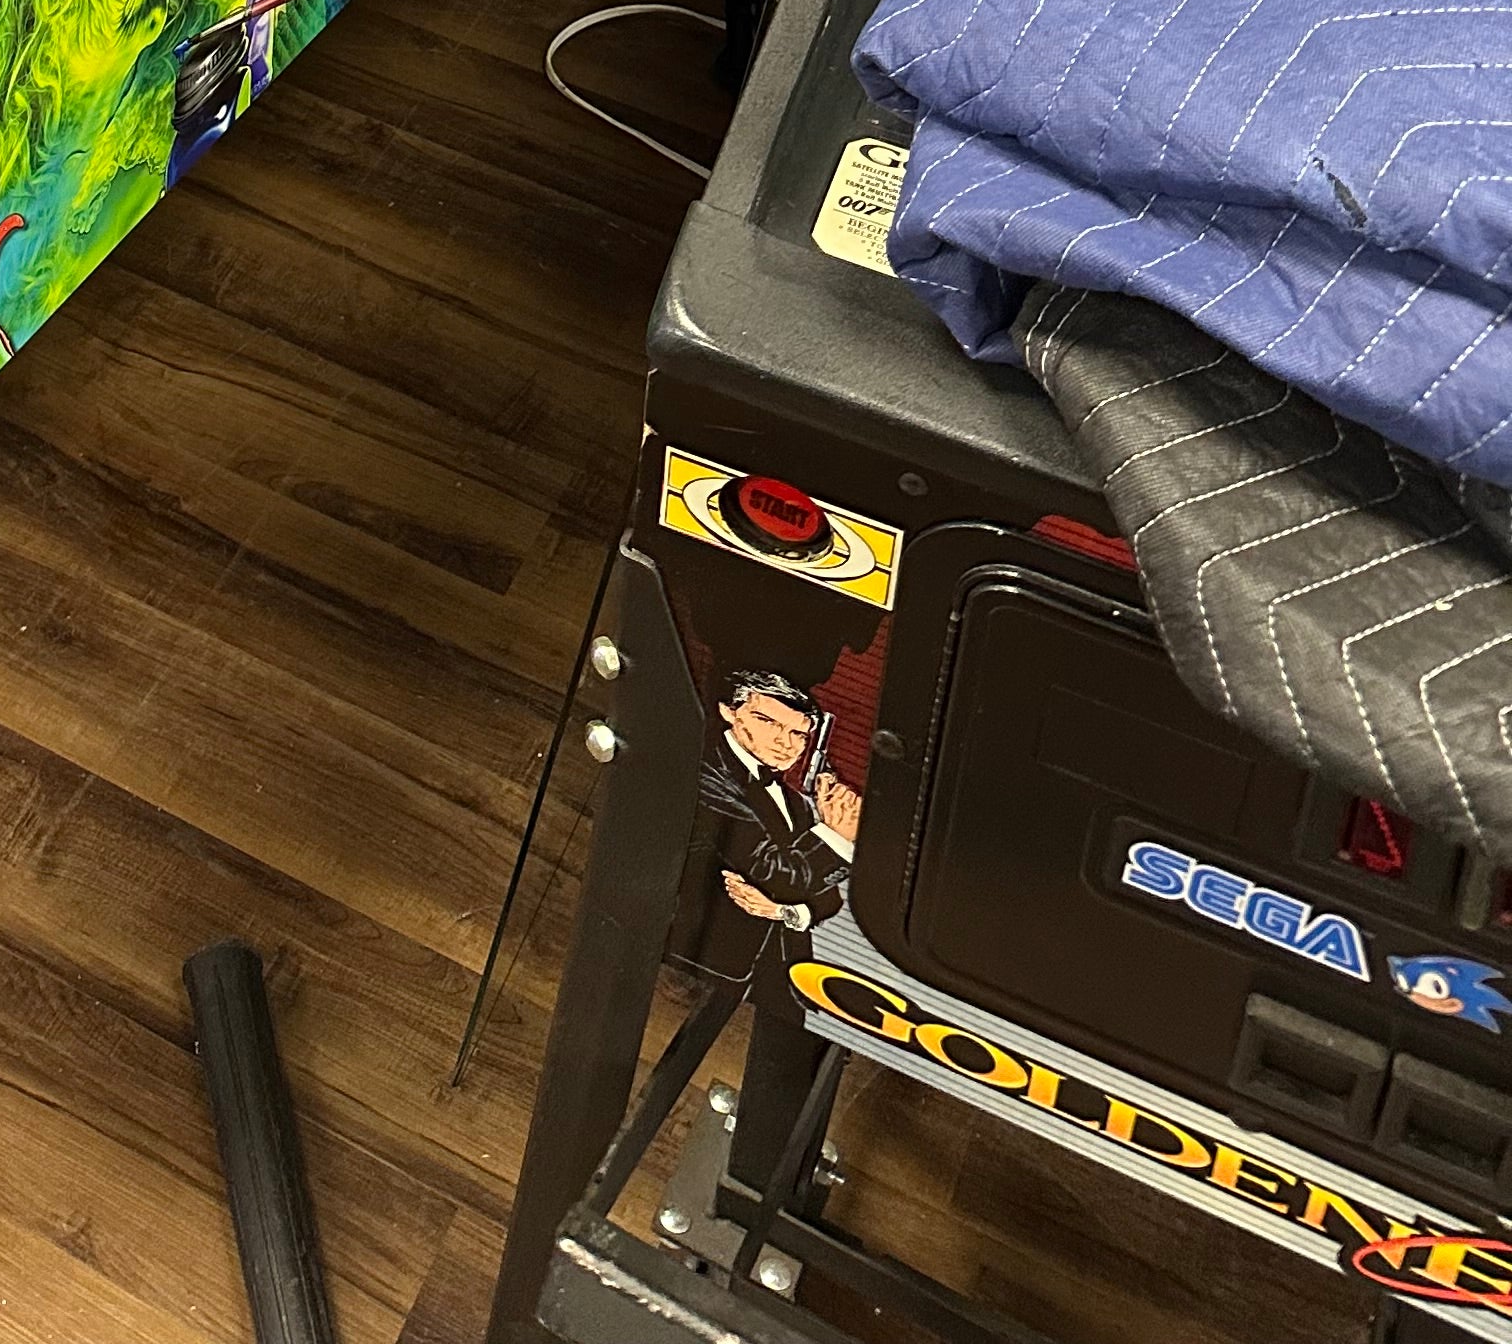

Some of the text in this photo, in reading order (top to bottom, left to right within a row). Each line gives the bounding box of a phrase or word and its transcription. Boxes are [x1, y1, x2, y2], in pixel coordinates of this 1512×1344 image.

[838, 195, 883, 216] 007
[748, 488, 811, 530] START
[1120, 839, 1371, 983] SEGA
[788, 960, 1512, 1304] GOLDENE
